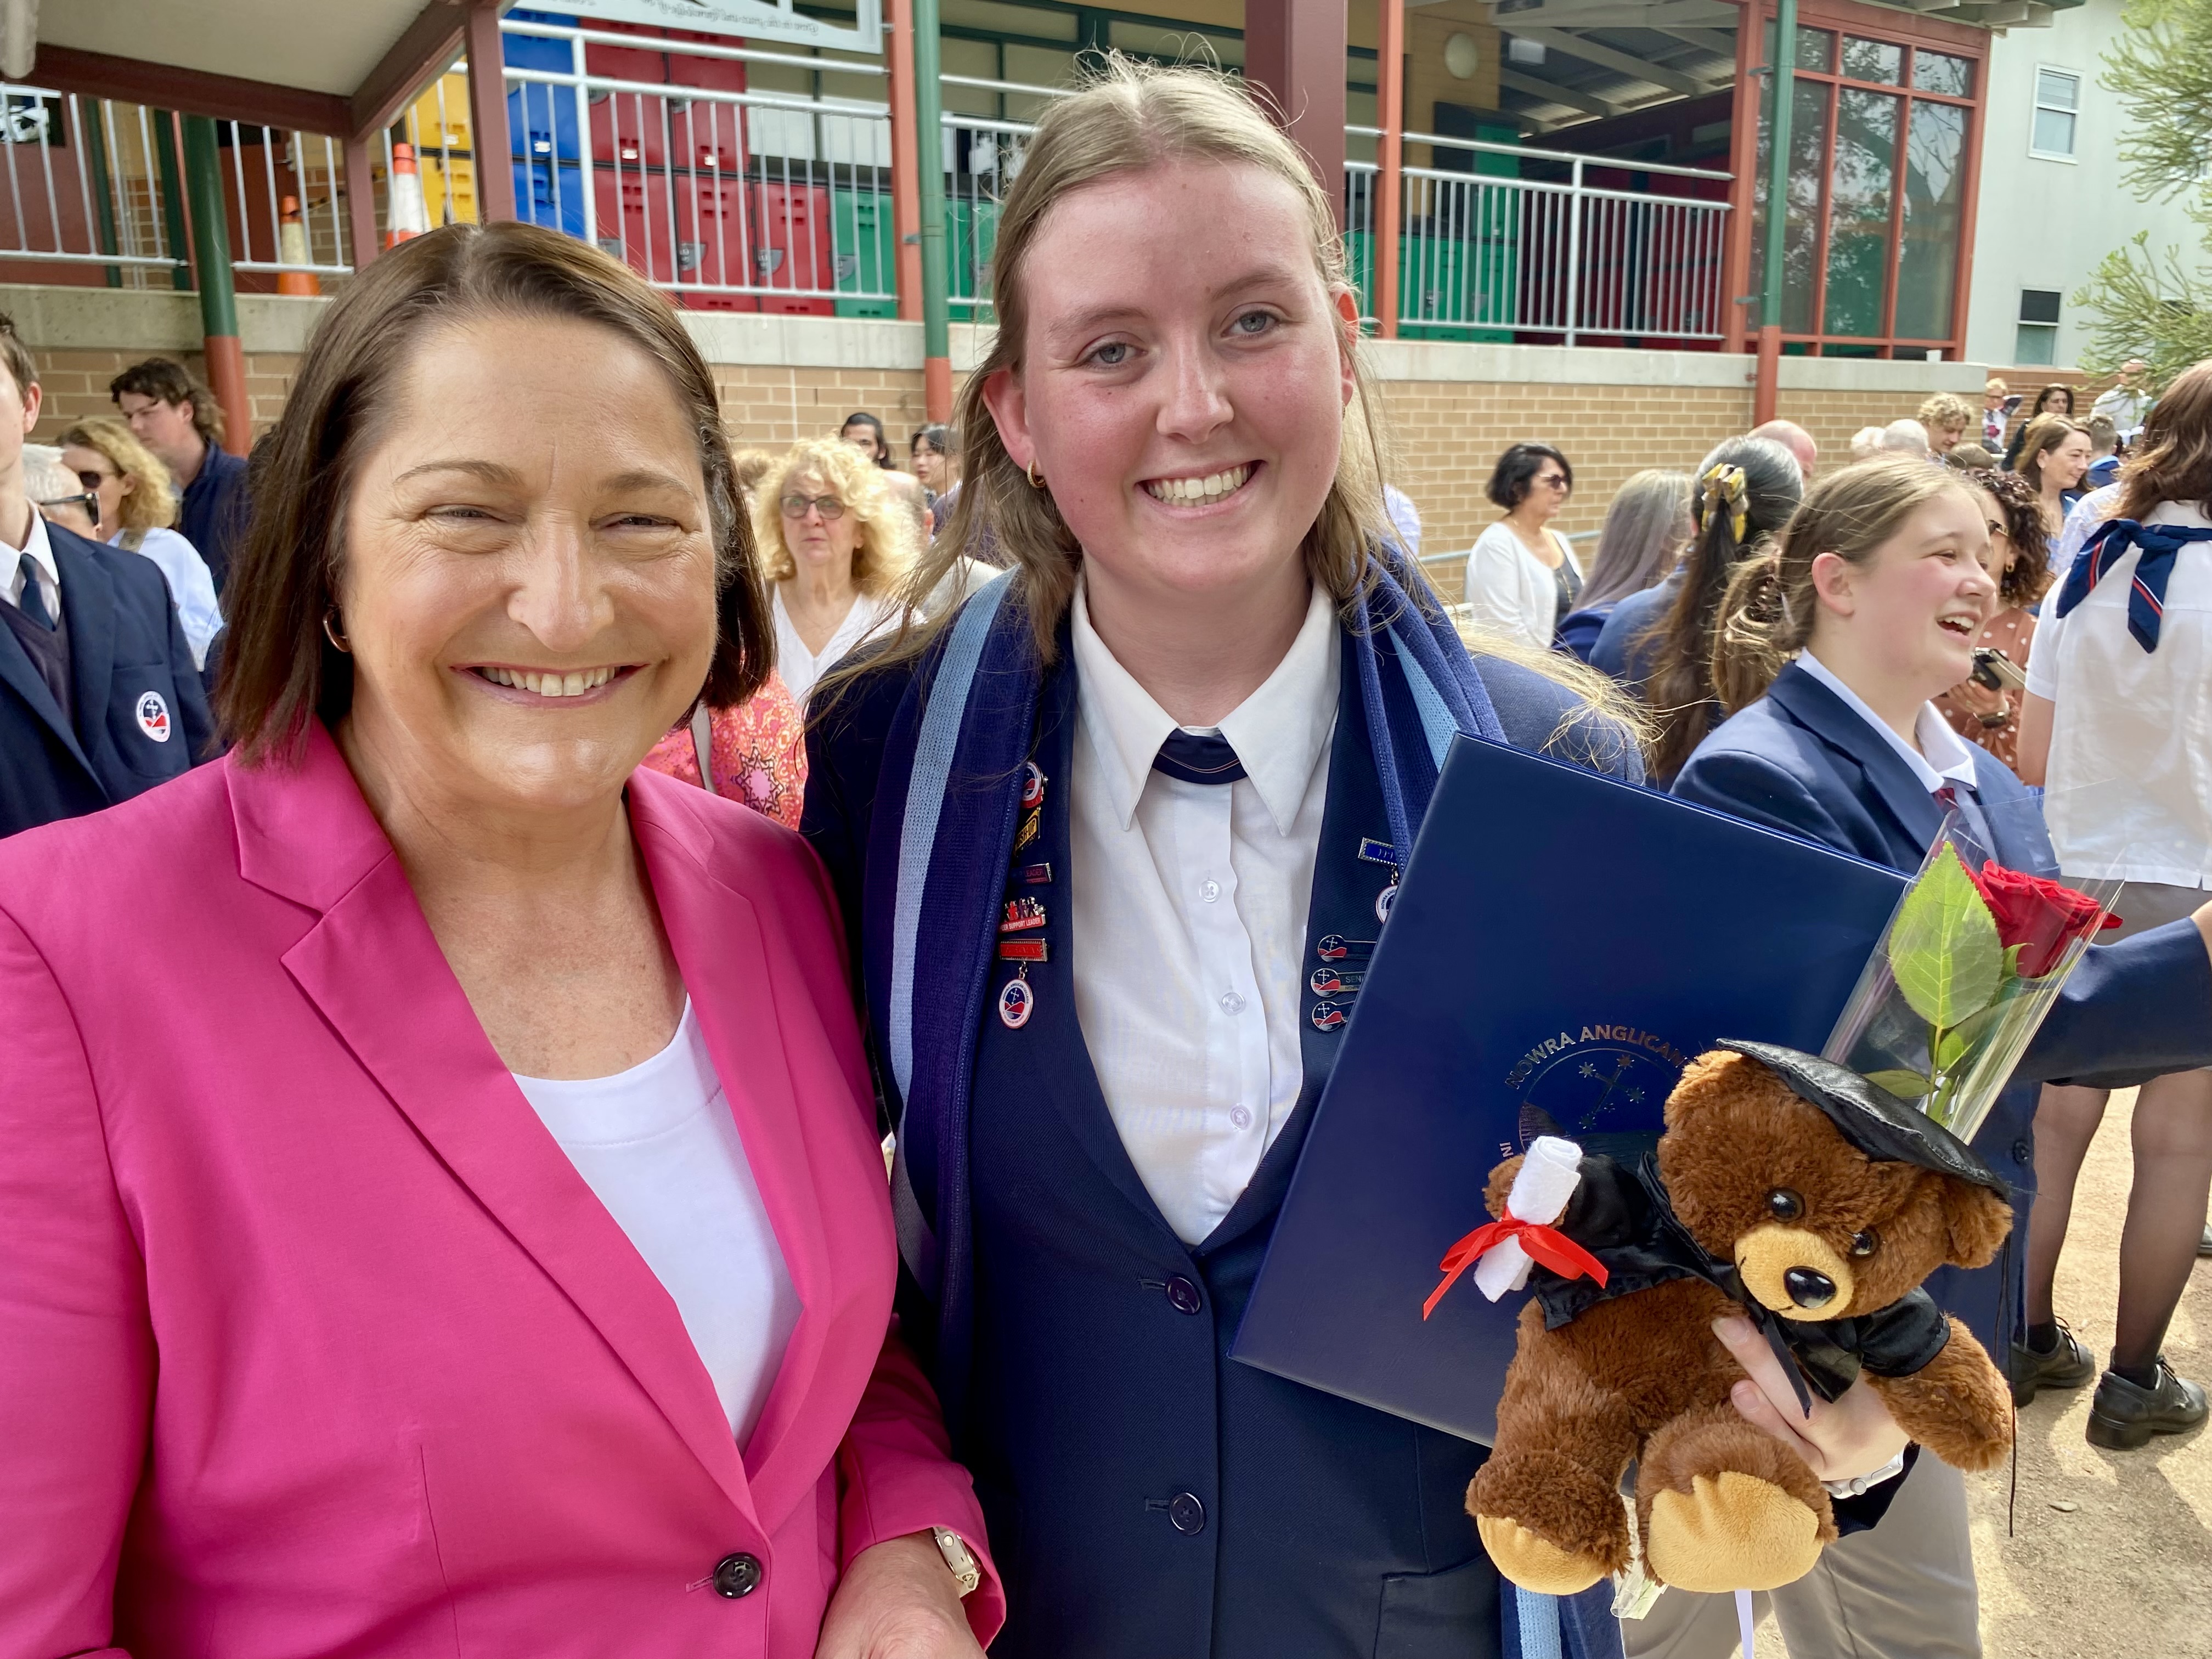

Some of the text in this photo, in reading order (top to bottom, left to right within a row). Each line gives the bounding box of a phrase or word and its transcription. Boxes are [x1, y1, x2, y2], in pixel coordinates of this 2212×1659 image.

[1017, 819, 1035, 848] USH-UP
[1024, 868, 1043, 877] LEADER
[1009, 920, 1026, 930] SUPPORT
[1026, 917, 1041, 926] LEADER
[1504, 1024, 1688, 1090] NOWRA ANGLICAN
